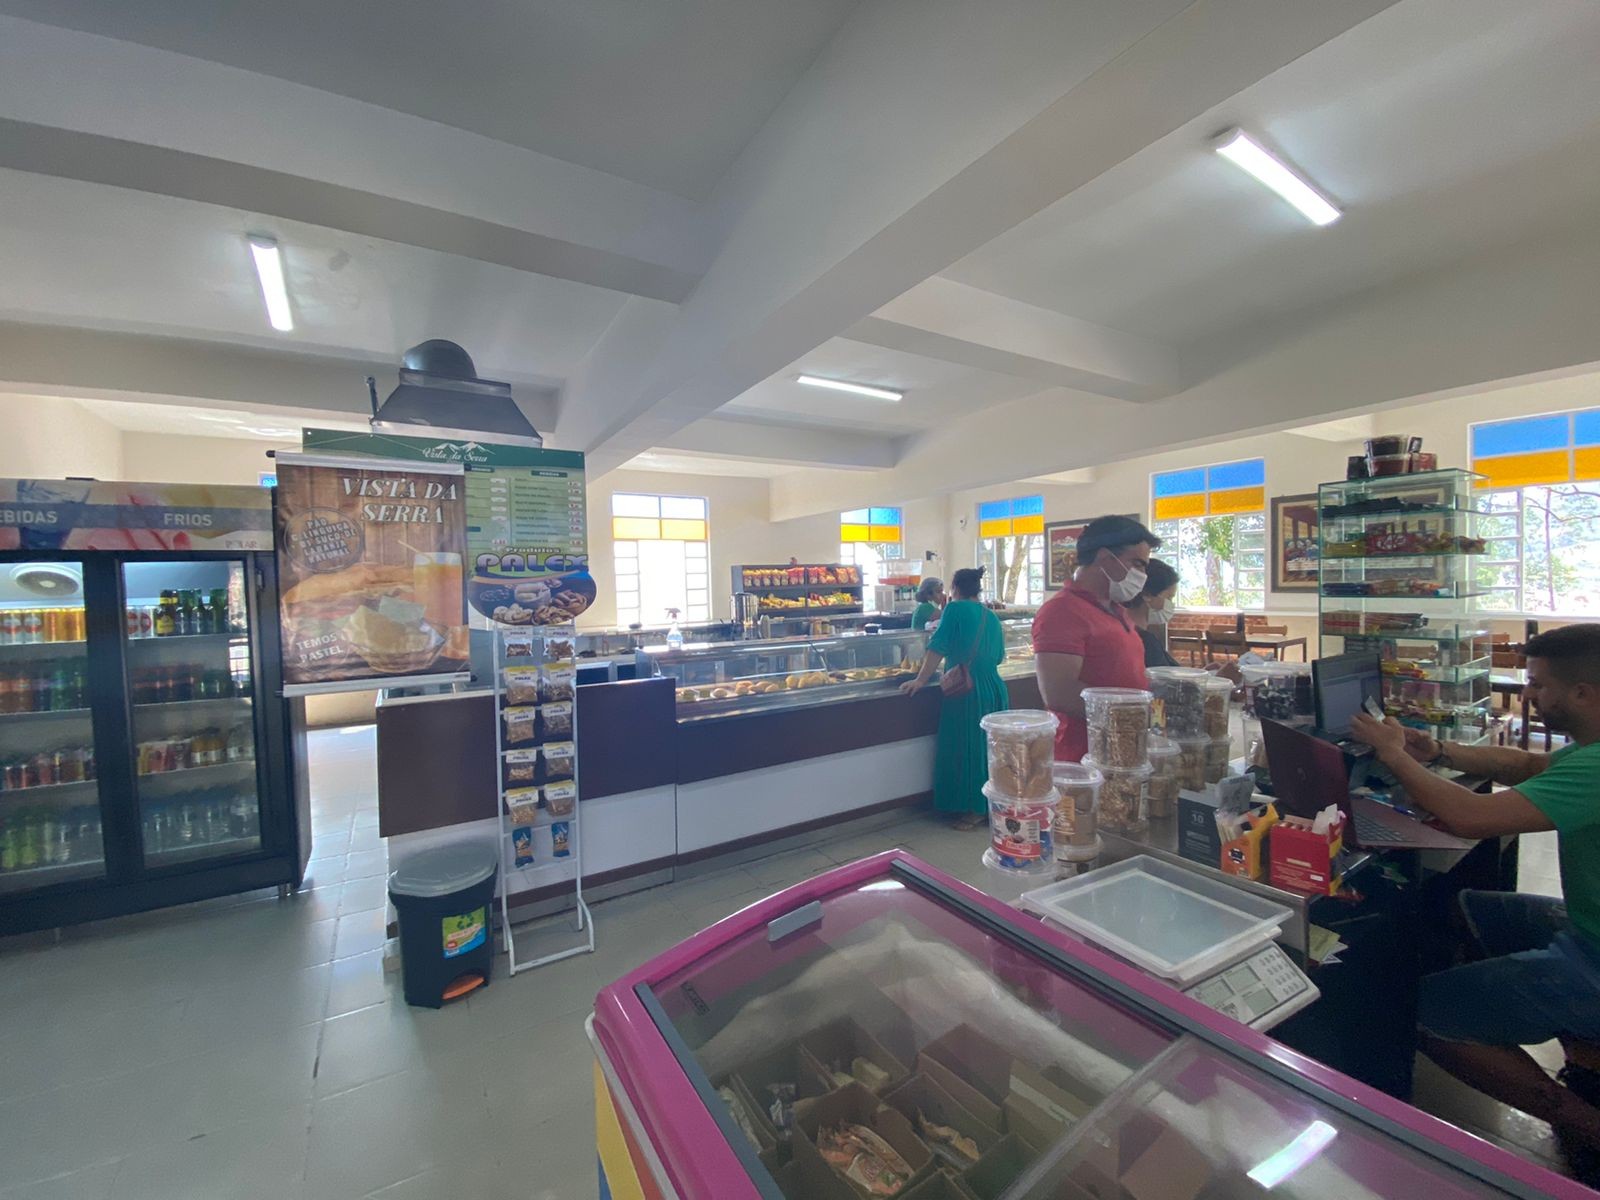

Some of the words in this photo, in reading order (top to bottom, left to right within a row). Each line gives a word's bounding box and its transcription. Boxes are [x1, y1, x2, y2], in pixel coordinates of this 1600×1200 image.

[342, 478, 417, 498] VISTA
[424, 482, 457, 500] DA
[163, 513, 213, 527] FRIOS
[361, 504, 443, 523] SERRA
[475, 553, 589, 575] PALEX
[296, 632, 337, 650] TEMOS
[300, 645, 344, 663] PASTEL
